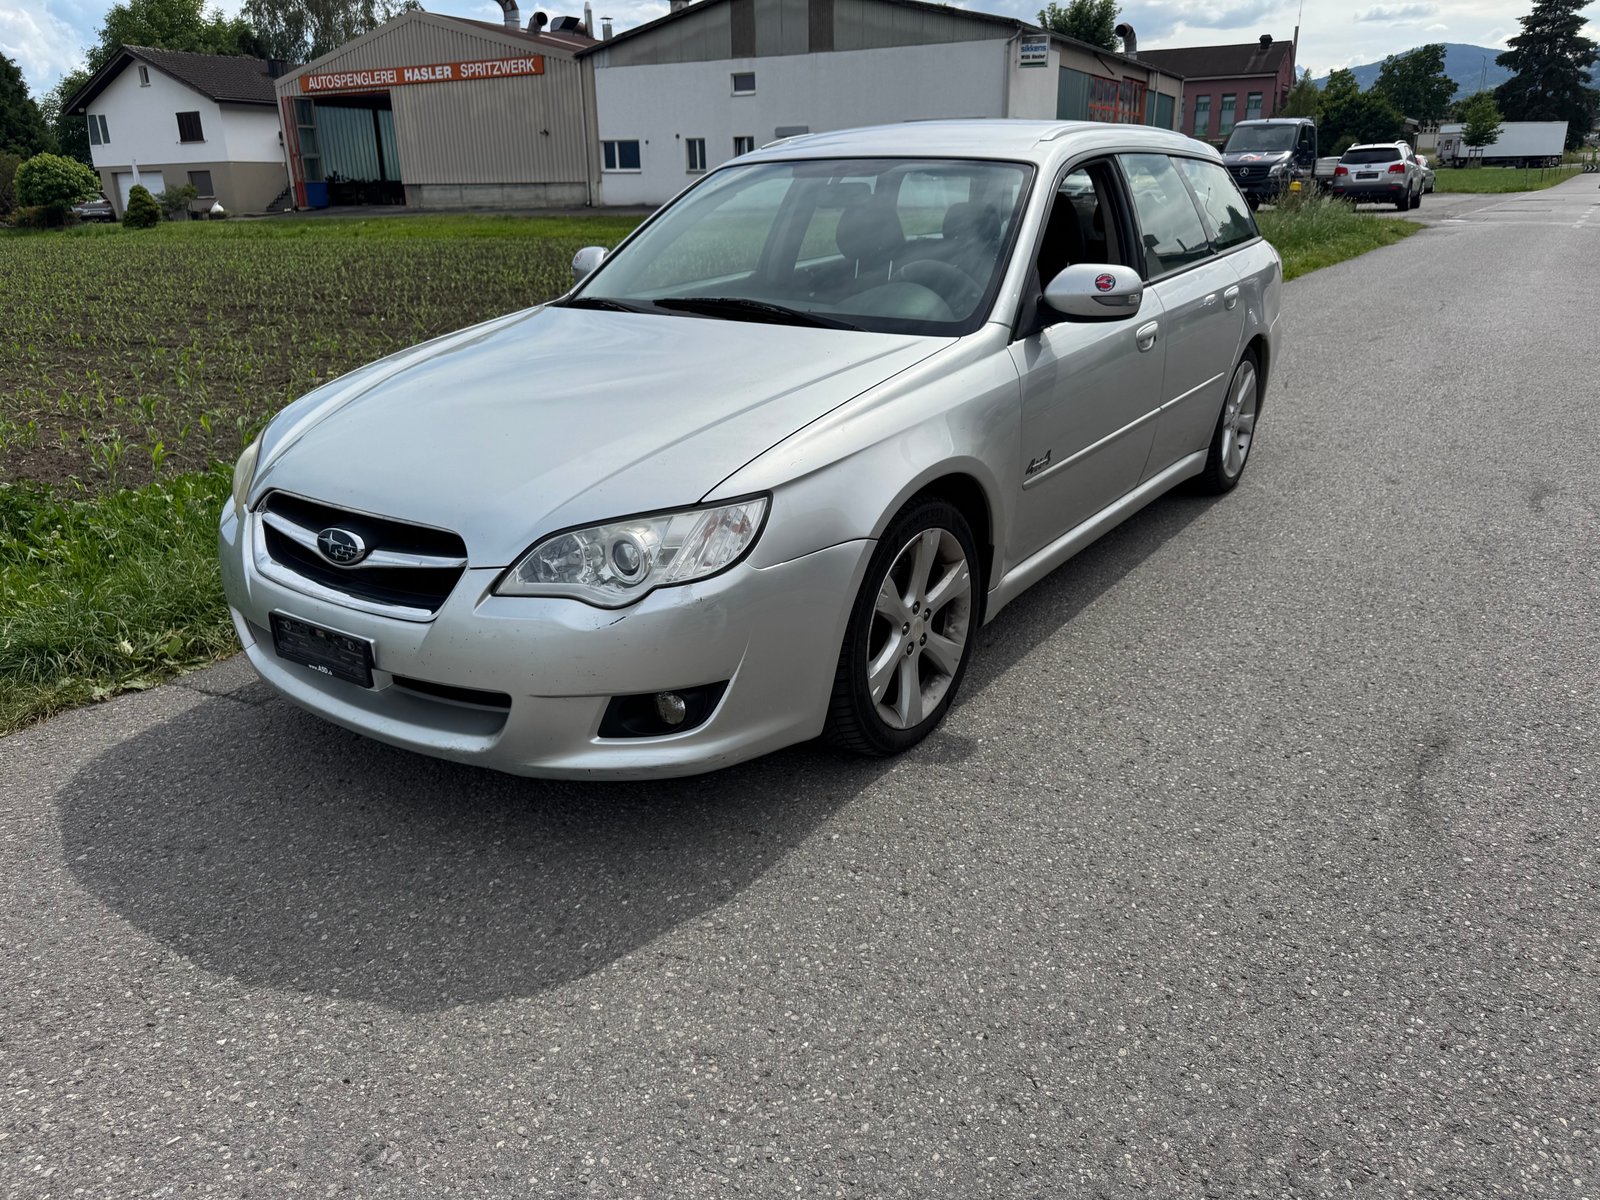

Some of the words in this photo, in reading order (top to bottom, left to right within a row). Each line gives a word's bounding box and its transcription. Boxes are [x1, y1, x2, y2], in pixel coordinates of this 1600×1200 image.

[308, 69, 397, 90] AUTOSPENGLEREI
[404, 65, 452, 80] HASLER
[460, 58, 536, 78] SPRITZWERK
